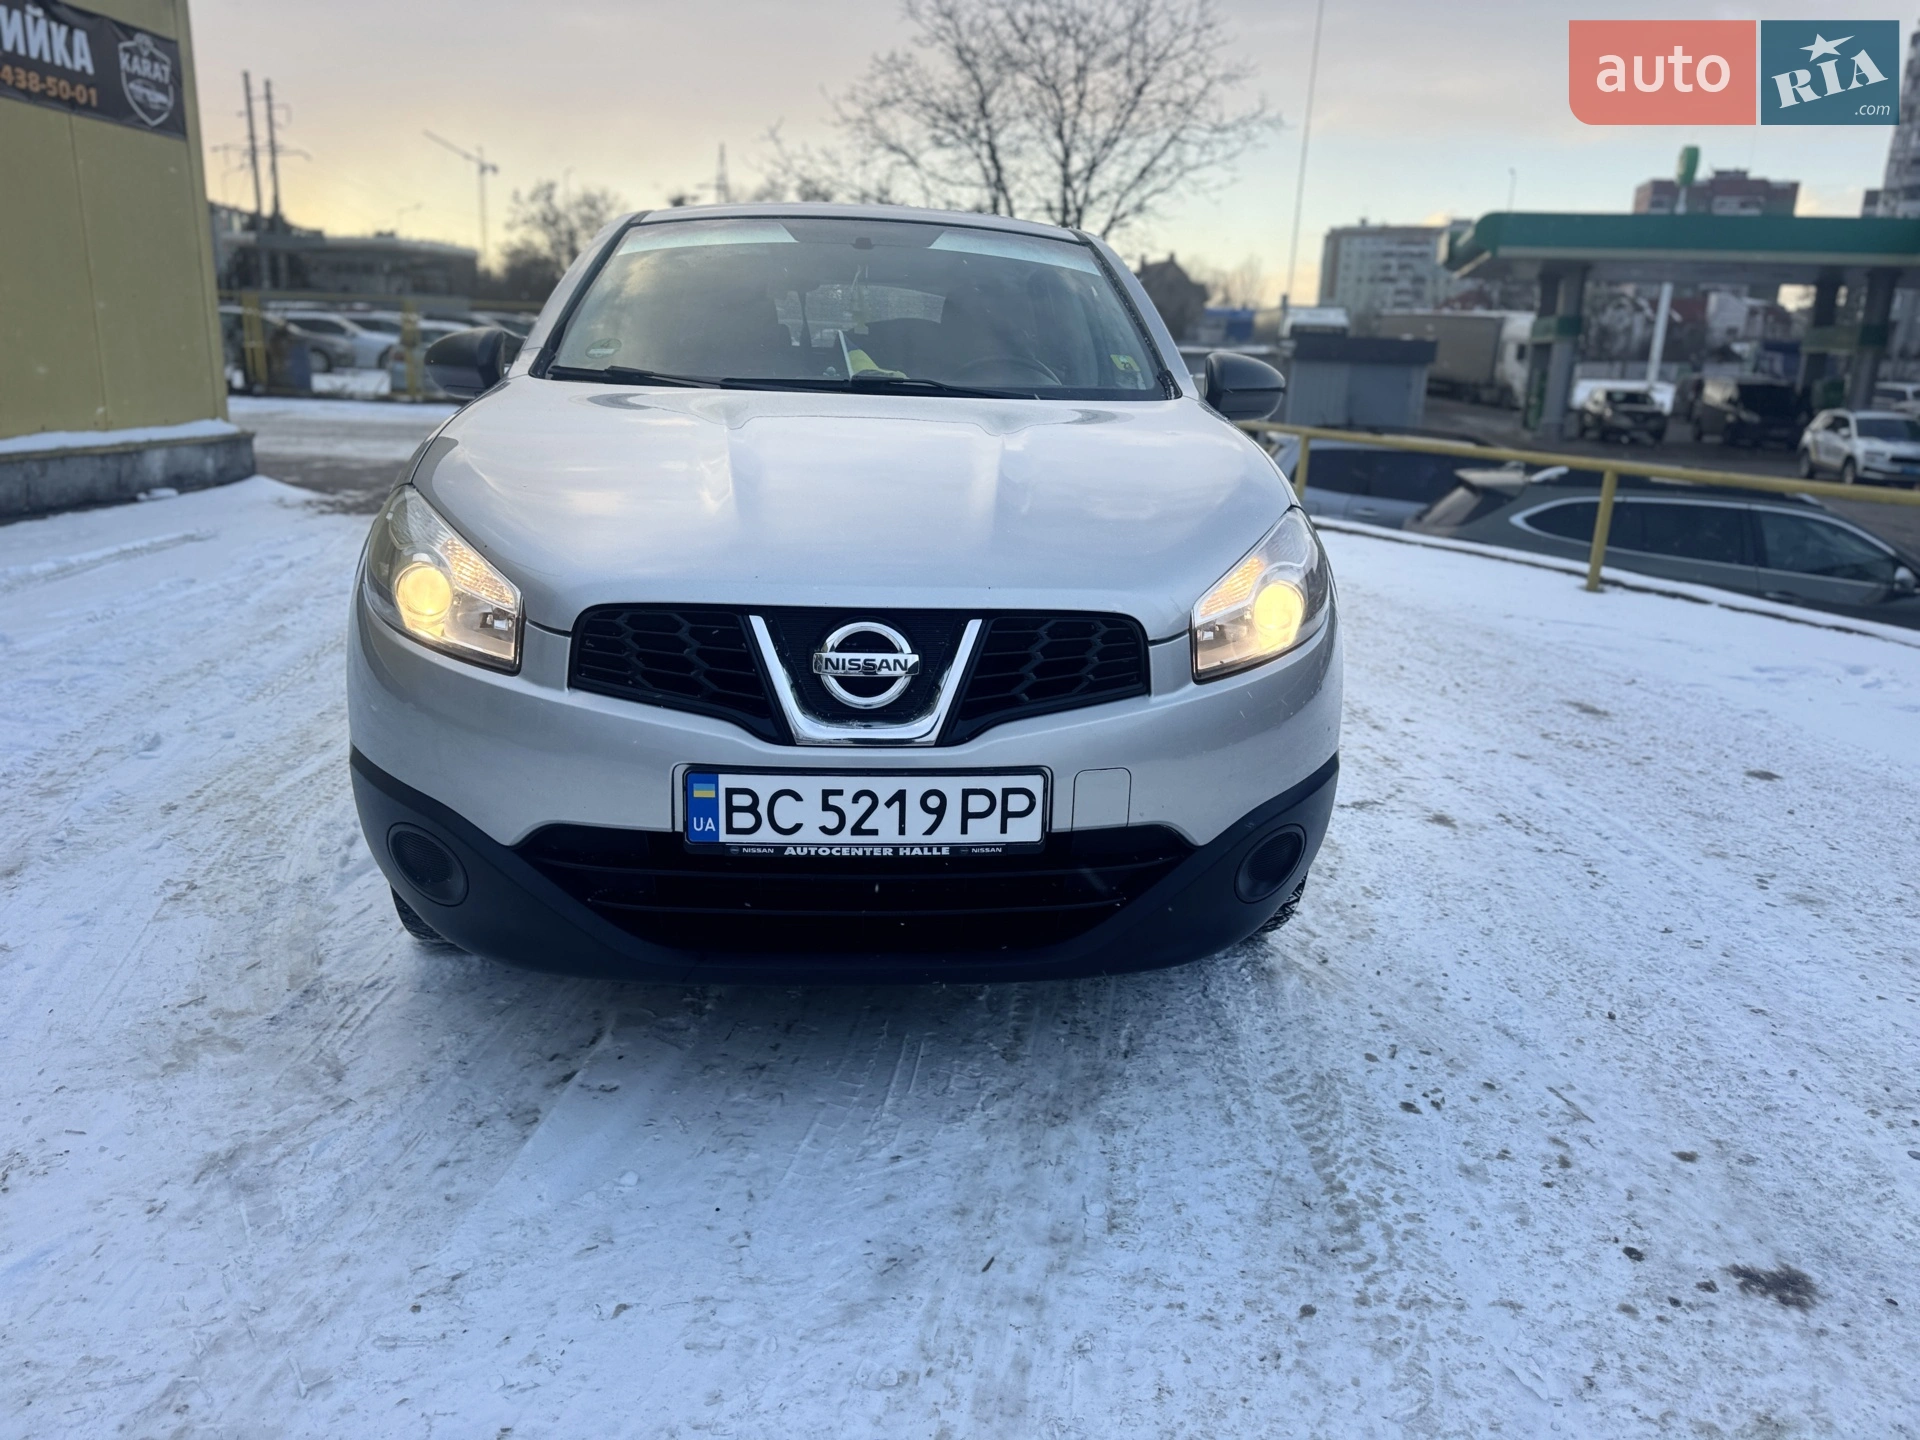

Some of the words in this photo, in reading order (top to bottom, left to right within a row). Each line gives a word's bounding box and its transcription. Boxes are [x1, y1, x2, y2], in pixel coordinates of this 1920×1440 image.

[120, 51, 170, 84] KARAT
[0, 64, 98, 107] 438-50-01
[824, 657, 908, 672] NISSAN
[725, 787, 804, 836] BC
[818, 788, 947, 836] 5219
[960, 787, 1036, 835] PP
[693, 817, 716, 832] UA
[784, 846, 893, 856] AUTOCENTER
[899, 846, 950, 856] HALLE
